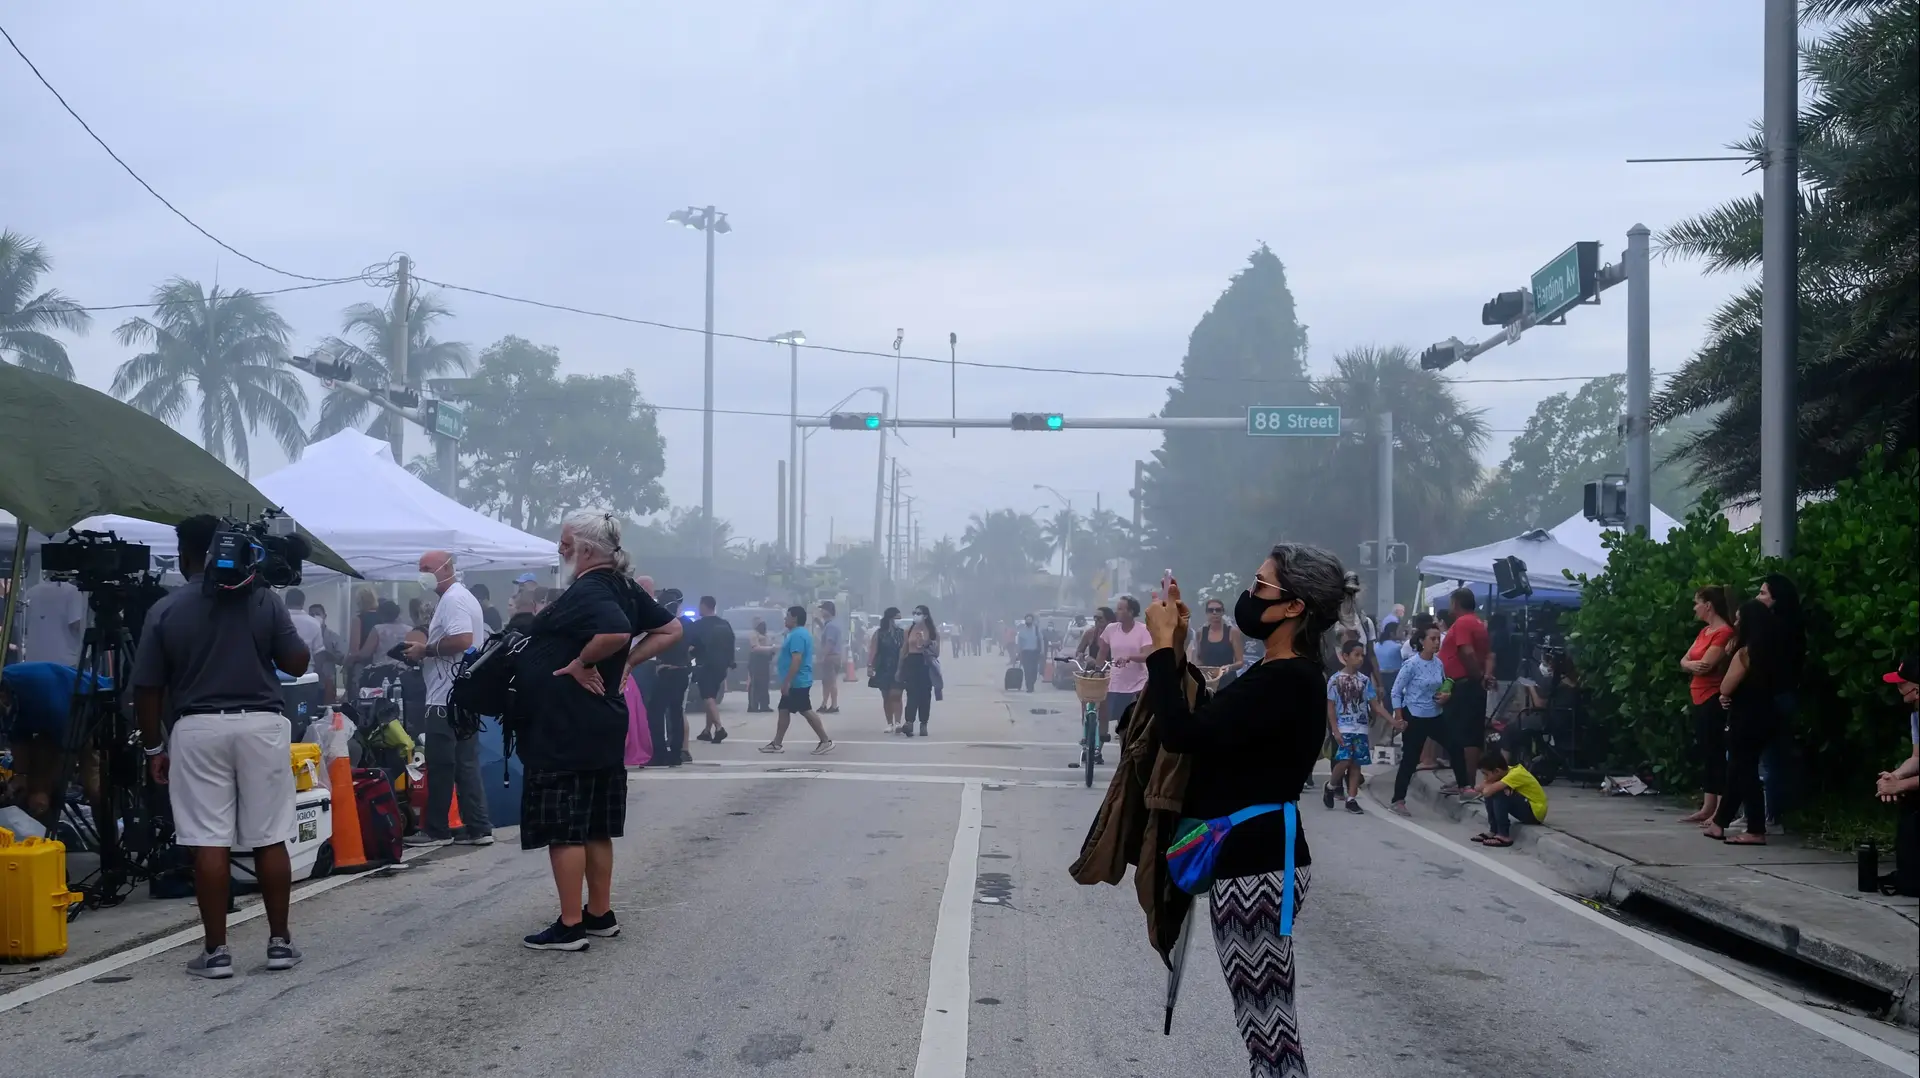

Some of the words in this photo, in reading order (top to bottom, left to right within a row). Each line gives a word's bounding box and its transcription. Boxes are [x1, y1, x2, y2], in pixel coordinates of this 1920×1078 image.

[1536, 276, 1564, 308] Harding
[1566, 265, 1575, 289] Av
[1255, 412, 1280, 430] 88
[1287, 413, 1334, 429] Street
